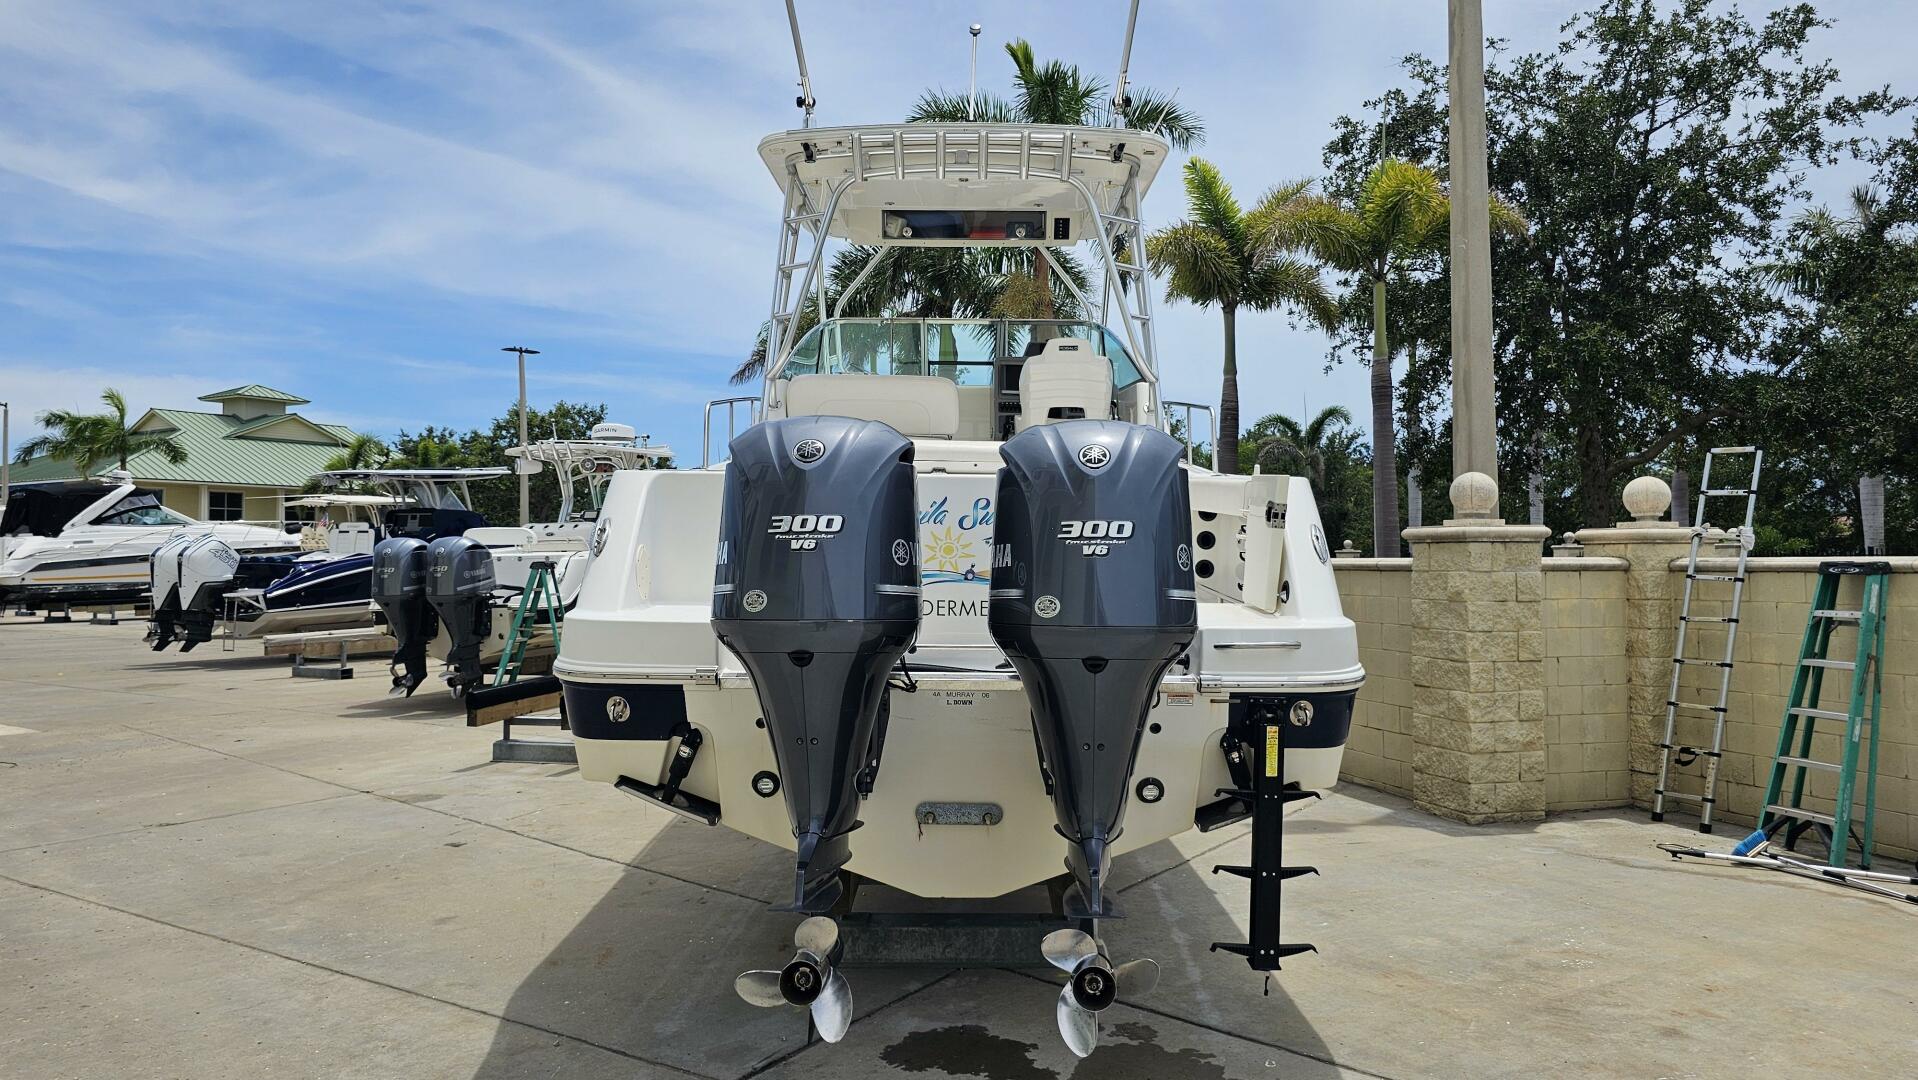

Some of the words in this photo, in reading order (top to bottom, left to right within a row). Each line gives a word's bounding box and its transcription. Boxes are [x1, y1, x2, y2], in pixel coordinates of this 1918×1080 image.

[958, 497, 995, 530] Su
[768, 515, 843, 533] 300
[1057, 520, 1133, 538] 300
[790, 540, 817, 550] V6
[1082, 545, 1109, 555] V6
[922, 600, 989, 616] DERME
